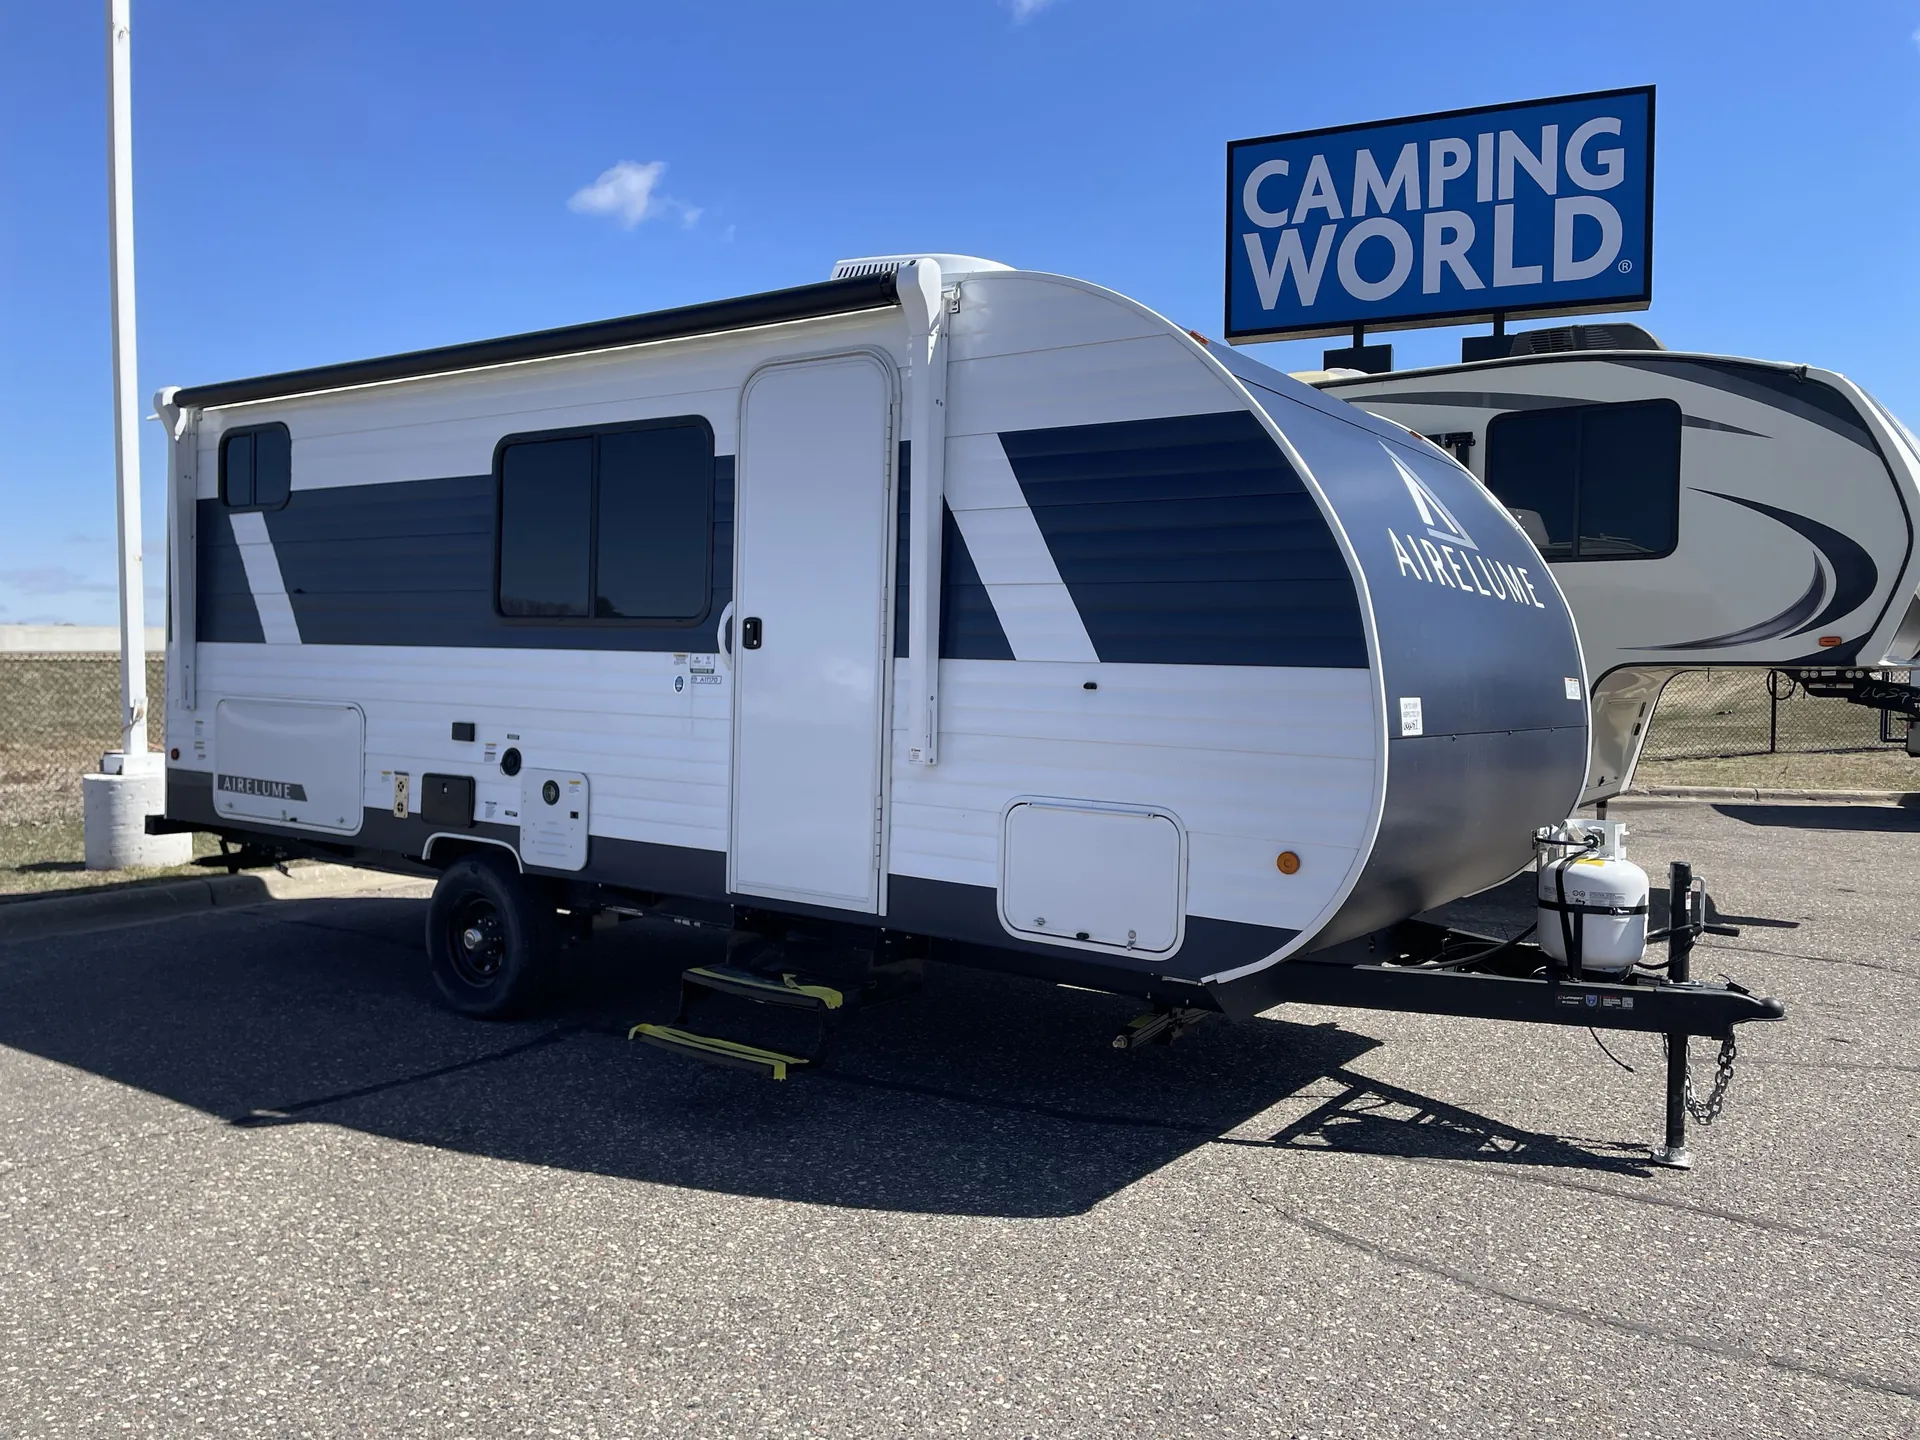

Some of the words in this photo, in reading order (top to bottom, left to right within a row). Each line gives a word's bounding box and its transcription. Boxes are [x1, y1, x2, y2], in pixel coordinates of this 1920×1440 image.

[1242, 116, 1625, 229] CAMPING
[1242, 194, 1624, 311] WORLD
[1387, 527, 1546, 609] AIRELUME
[223, 776, 291, 799] AIRELUME
